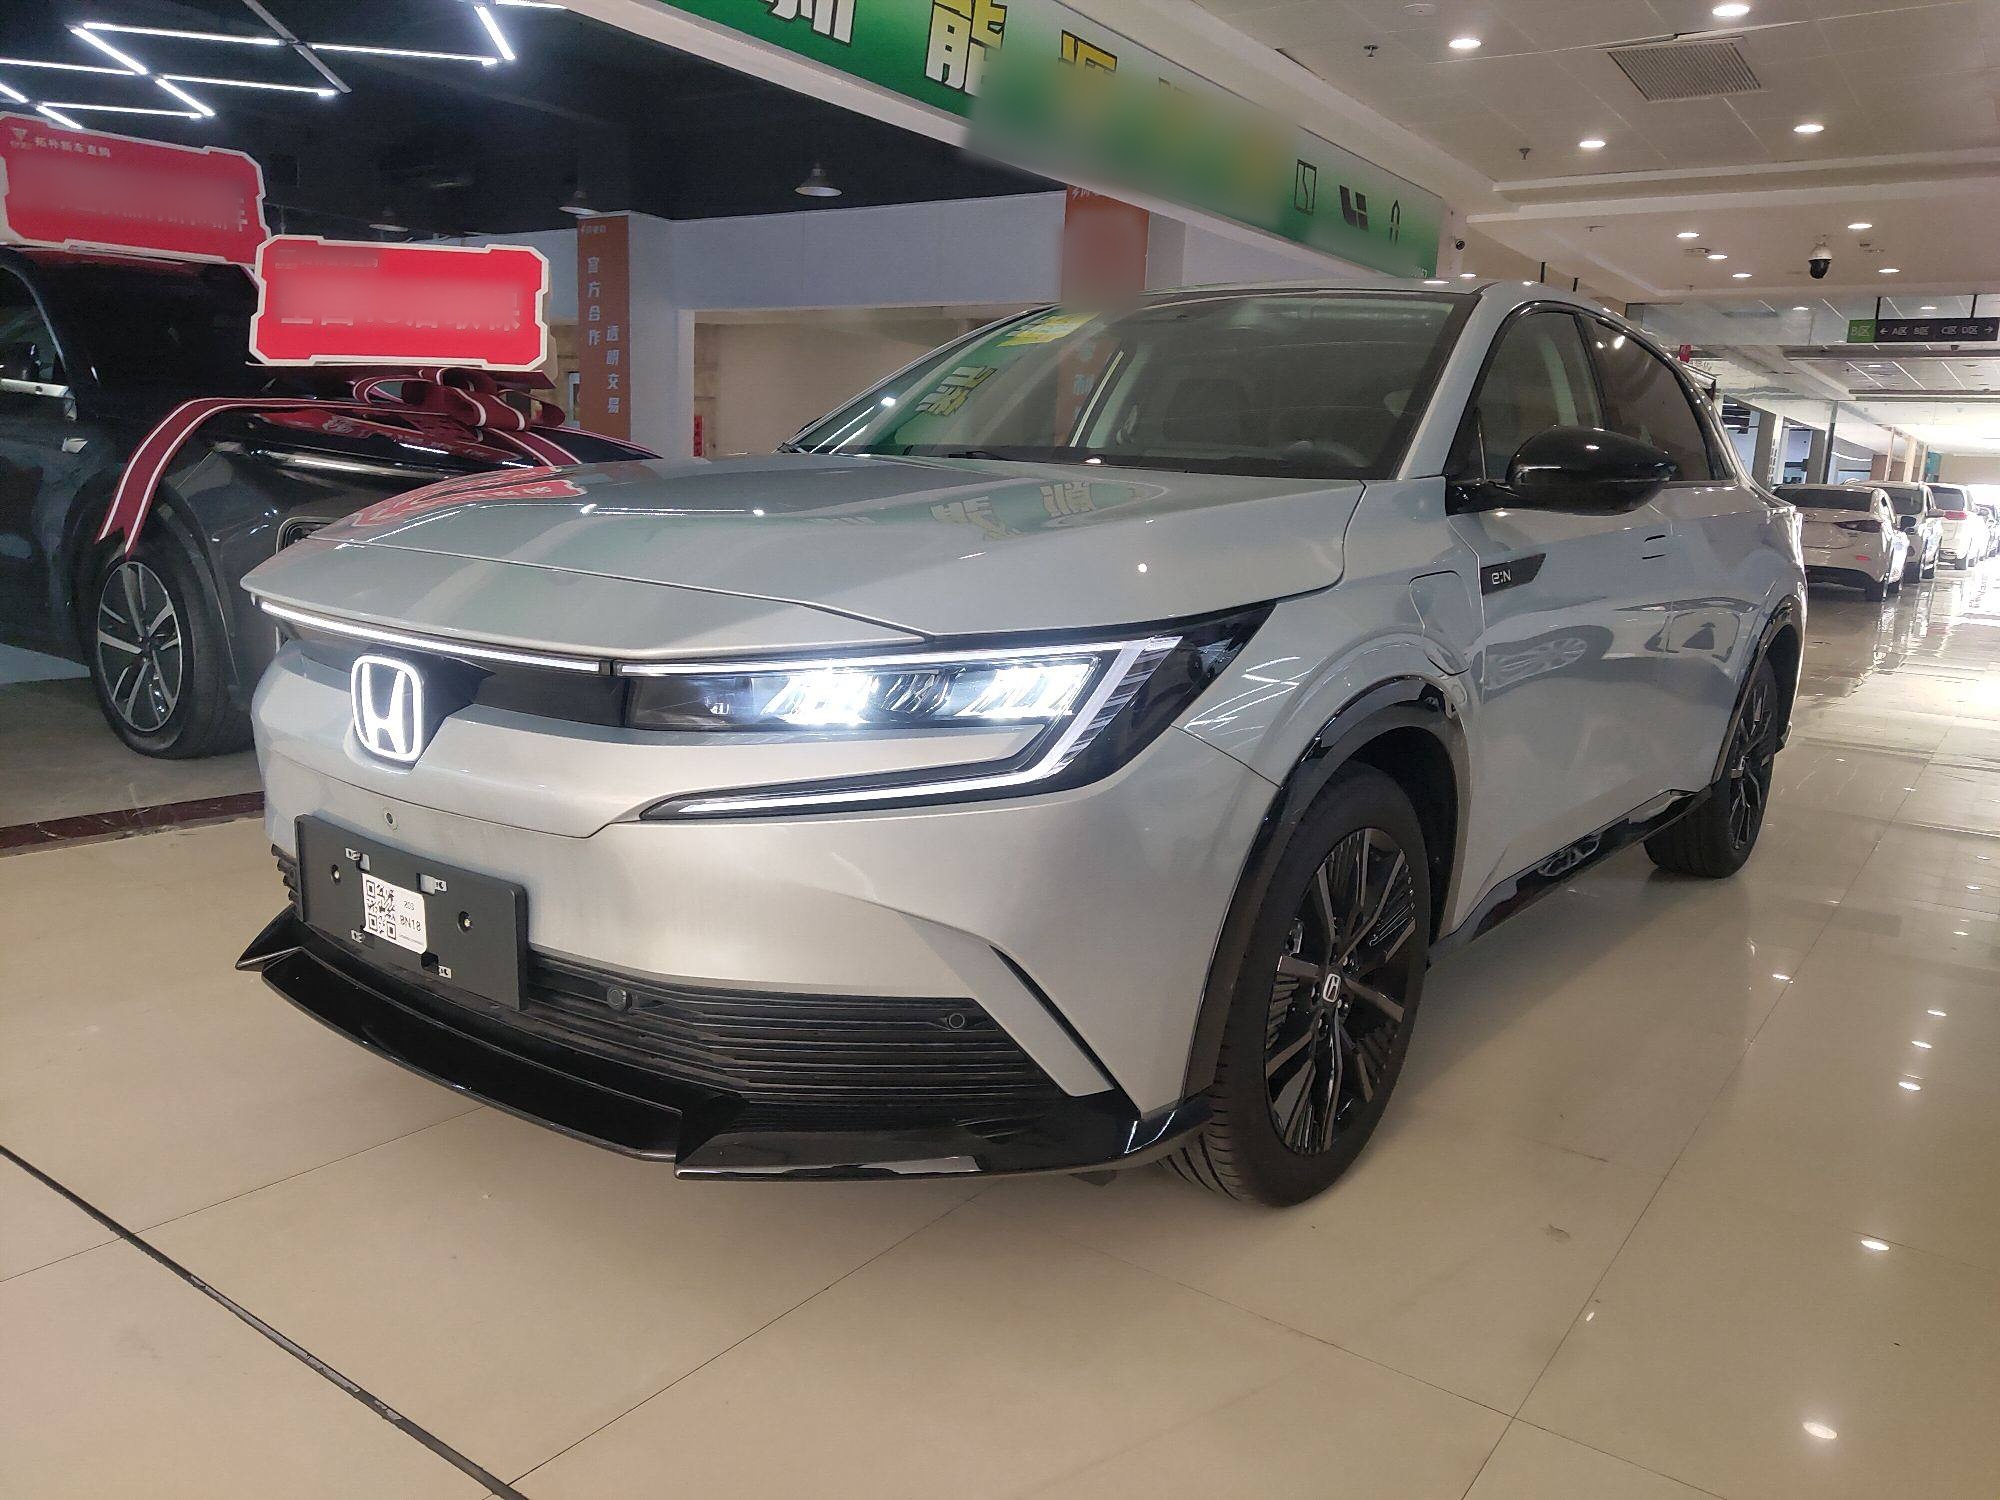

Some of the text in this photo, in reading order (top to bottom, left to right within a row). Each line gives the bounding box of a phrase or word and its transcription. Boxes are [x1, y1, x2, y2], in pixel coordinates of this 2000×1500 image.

[586, 256, 601, 346] 官方合作
[1850, 325, 1871, 337] B区
[605, 325, 620, 414] 透明交易
